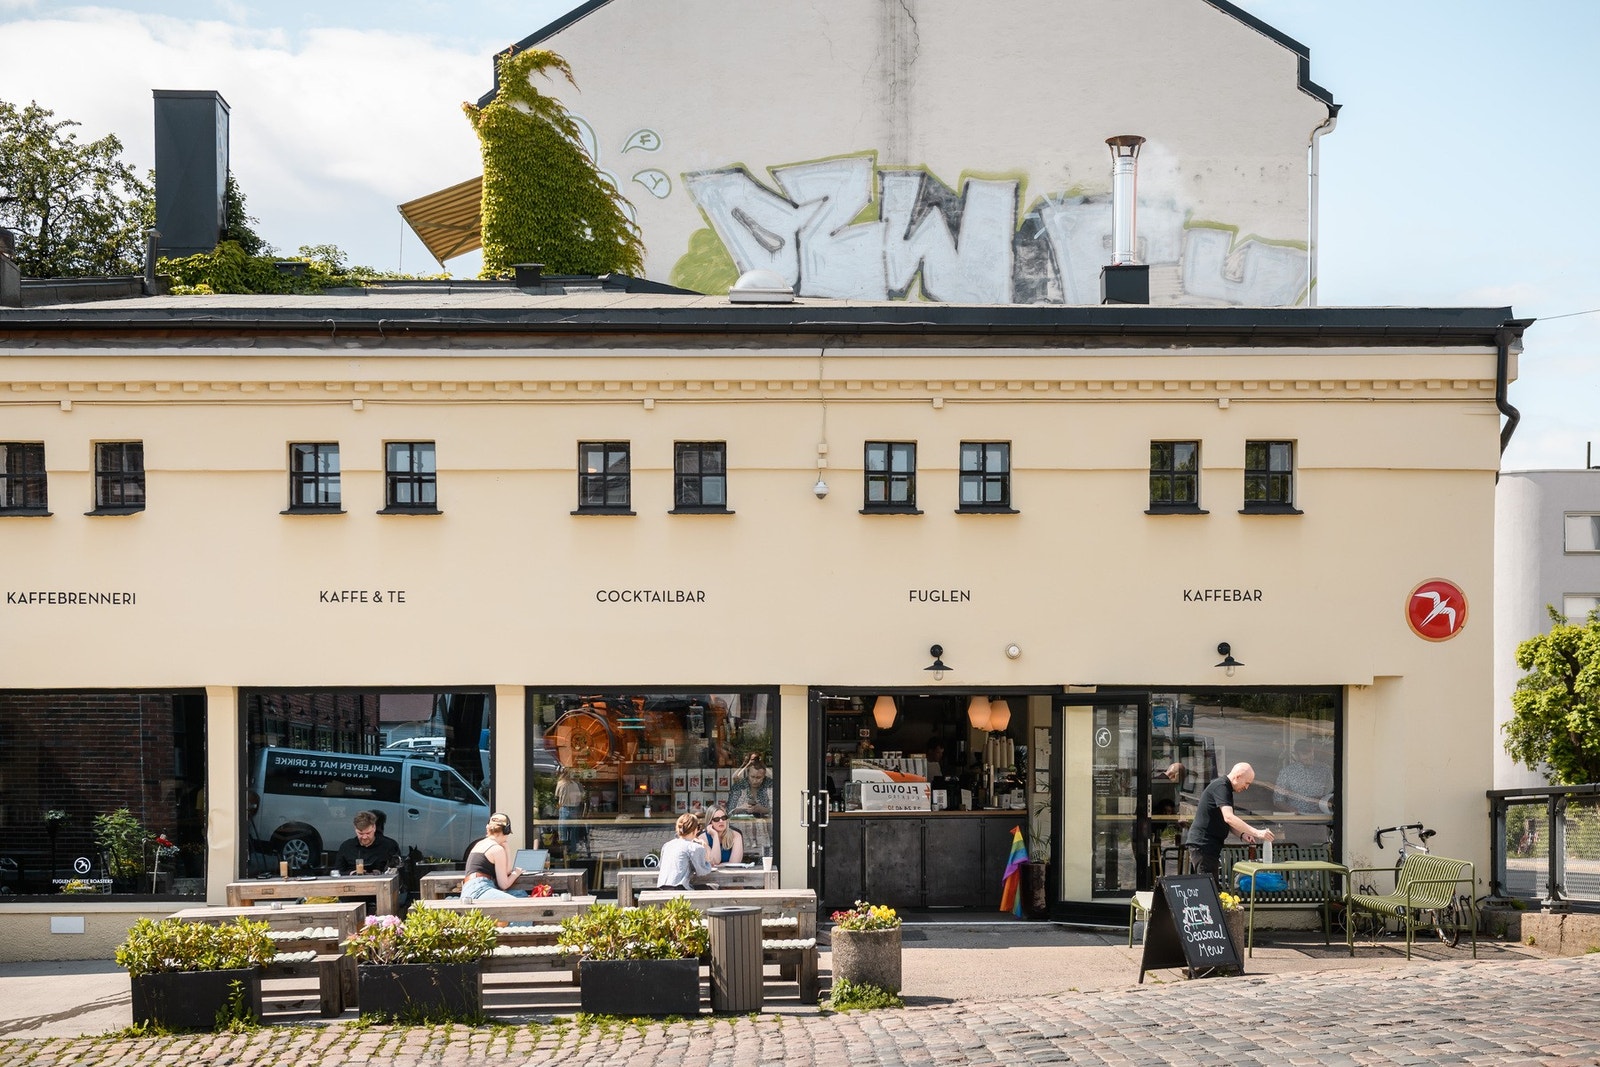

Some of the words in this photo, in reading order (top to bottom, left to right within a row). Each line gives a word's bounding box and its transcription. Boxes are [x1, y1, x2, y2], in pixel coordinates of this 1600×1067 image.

[7, 591, 136, 605] KAFFEBRENNERI
[319, 590, 368, 603] KAFFE
[372, 590, 383, 603] &
[387, 590, 406, 603] TE
[596, 589, 706, 603] COCKTAILBAR
[909, 589, 971, 603] FUGLEN
[1183, 589, 1263, 602] KAFFEBAR
[1170, 884, 1189, 906] Try
[1187, 888, 1200, 897] our
[1185, 908, 1209, 923] NEW
[1183, 923, 1226, 943] Seasonal
